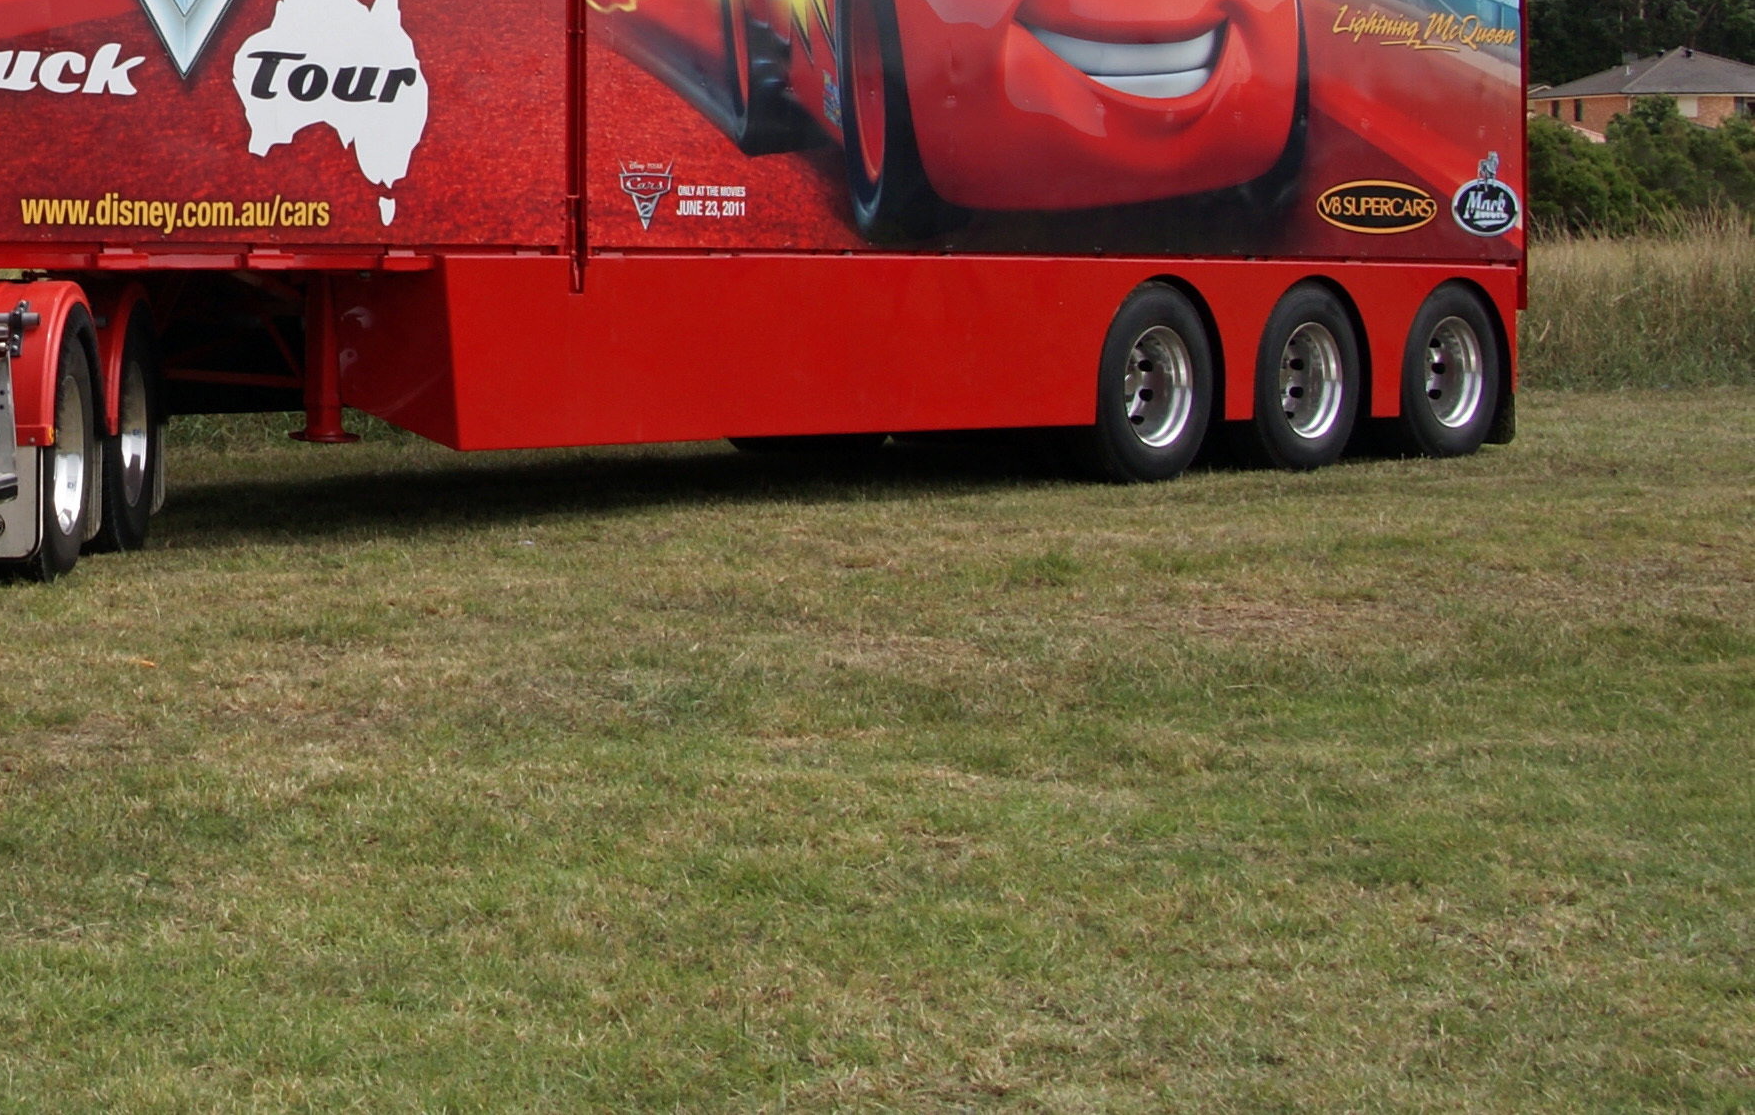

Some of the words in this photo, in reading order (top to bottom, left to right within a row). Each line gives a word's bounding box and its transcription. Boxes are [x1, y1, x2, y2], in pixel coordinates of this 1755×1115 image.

[1332, 3, 1419, 44] Lightning
[1423, 11, 1516, 51] McQueen
[247, 51, 417, 103] Tour
[625, 176, 664, 191] Cars
[677, 185, 695, 196] ONLY
[696, 185, 705, 196] AT
[706, 185, 719, 196] THE
[720, 186, 746, 197] MOVIES
[21, 193, 330, 234] www.disney.com.au/cars
[676, 200, 704, 216] JUNE
[705, 200, 721, 219] 23,
[723, 201, 746, 217] 2011
[1320, 195, 1342, 216] V8
[1344, 197, 1434, 218] SUPERCARS
[1463, 190, 1508, 222] Mack
